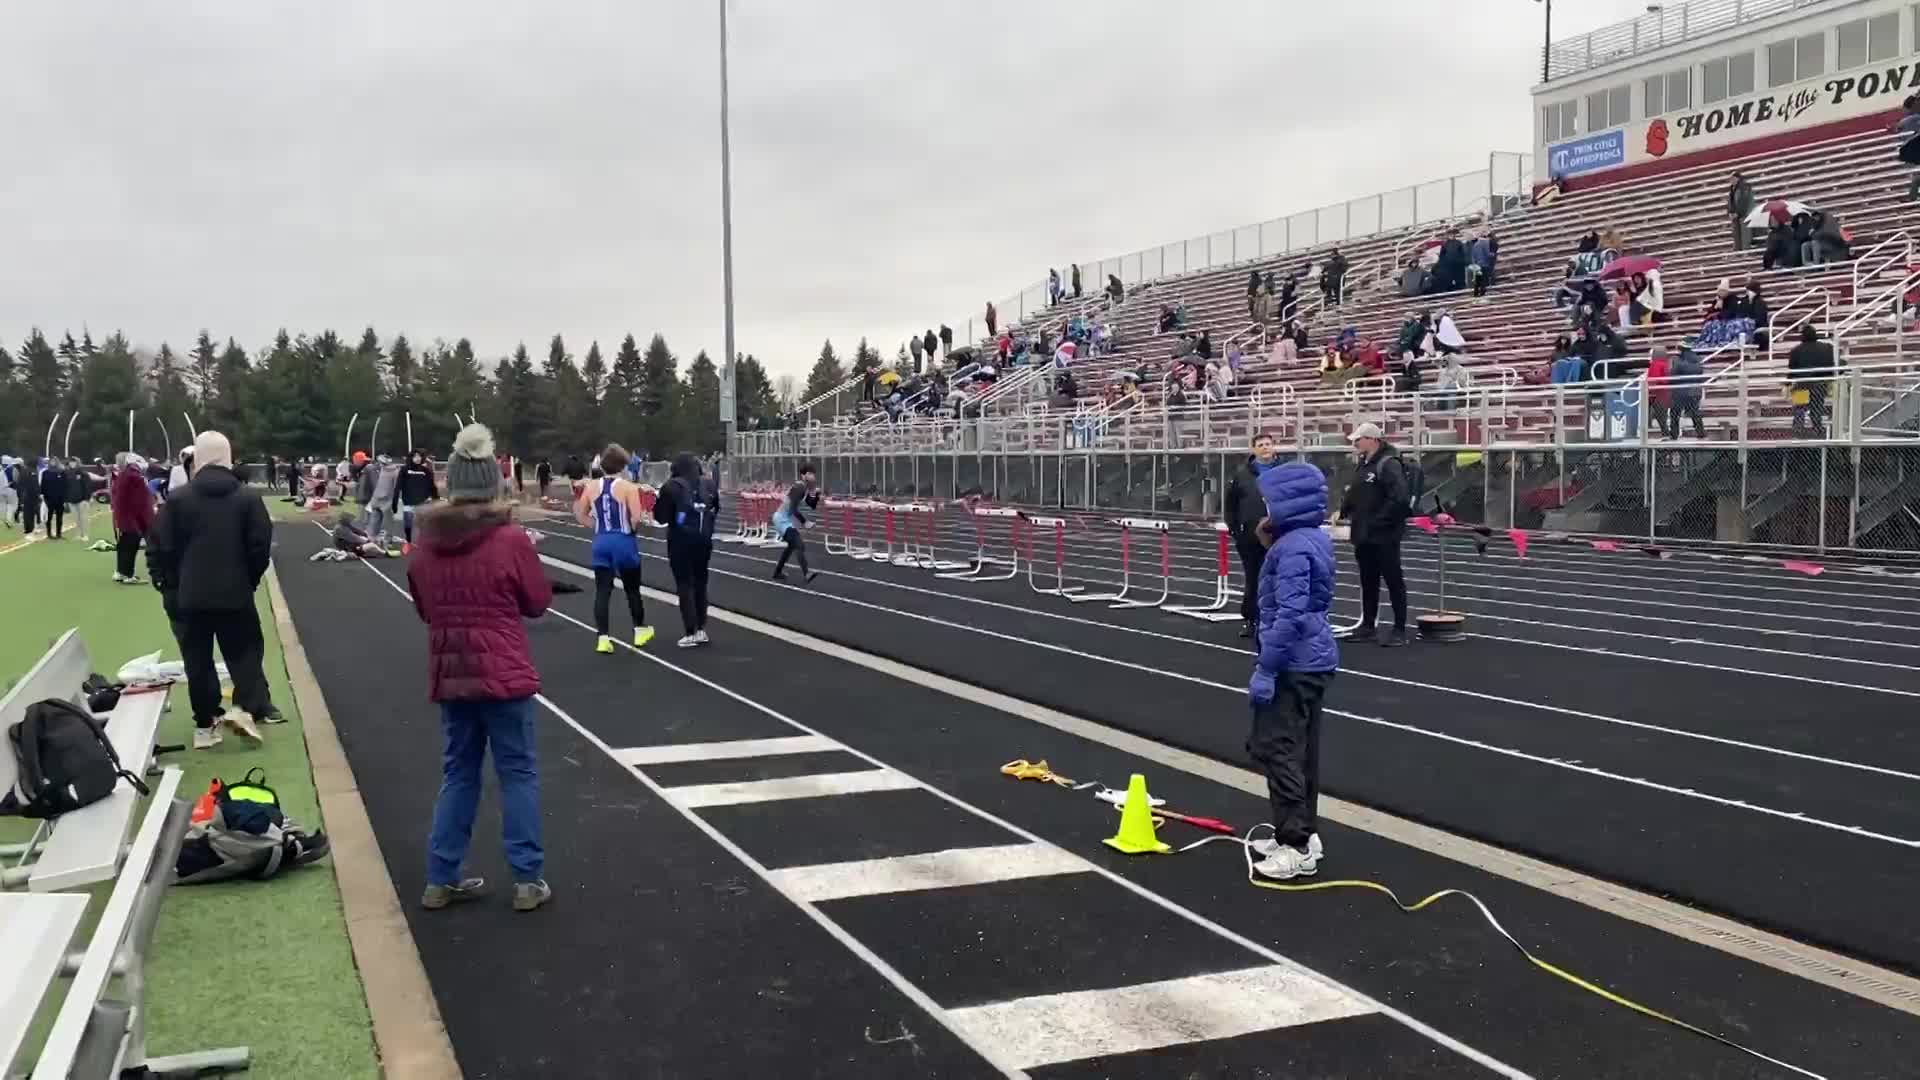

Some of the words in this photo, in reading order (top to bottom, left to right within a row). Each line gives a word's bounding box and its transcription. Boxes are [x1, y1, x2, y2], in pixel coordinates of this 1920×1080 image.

[1677, 96, 1775, 138] HOME
[1777, 92, 1794, 122] of
[1795, 88, 1818, 110] the
